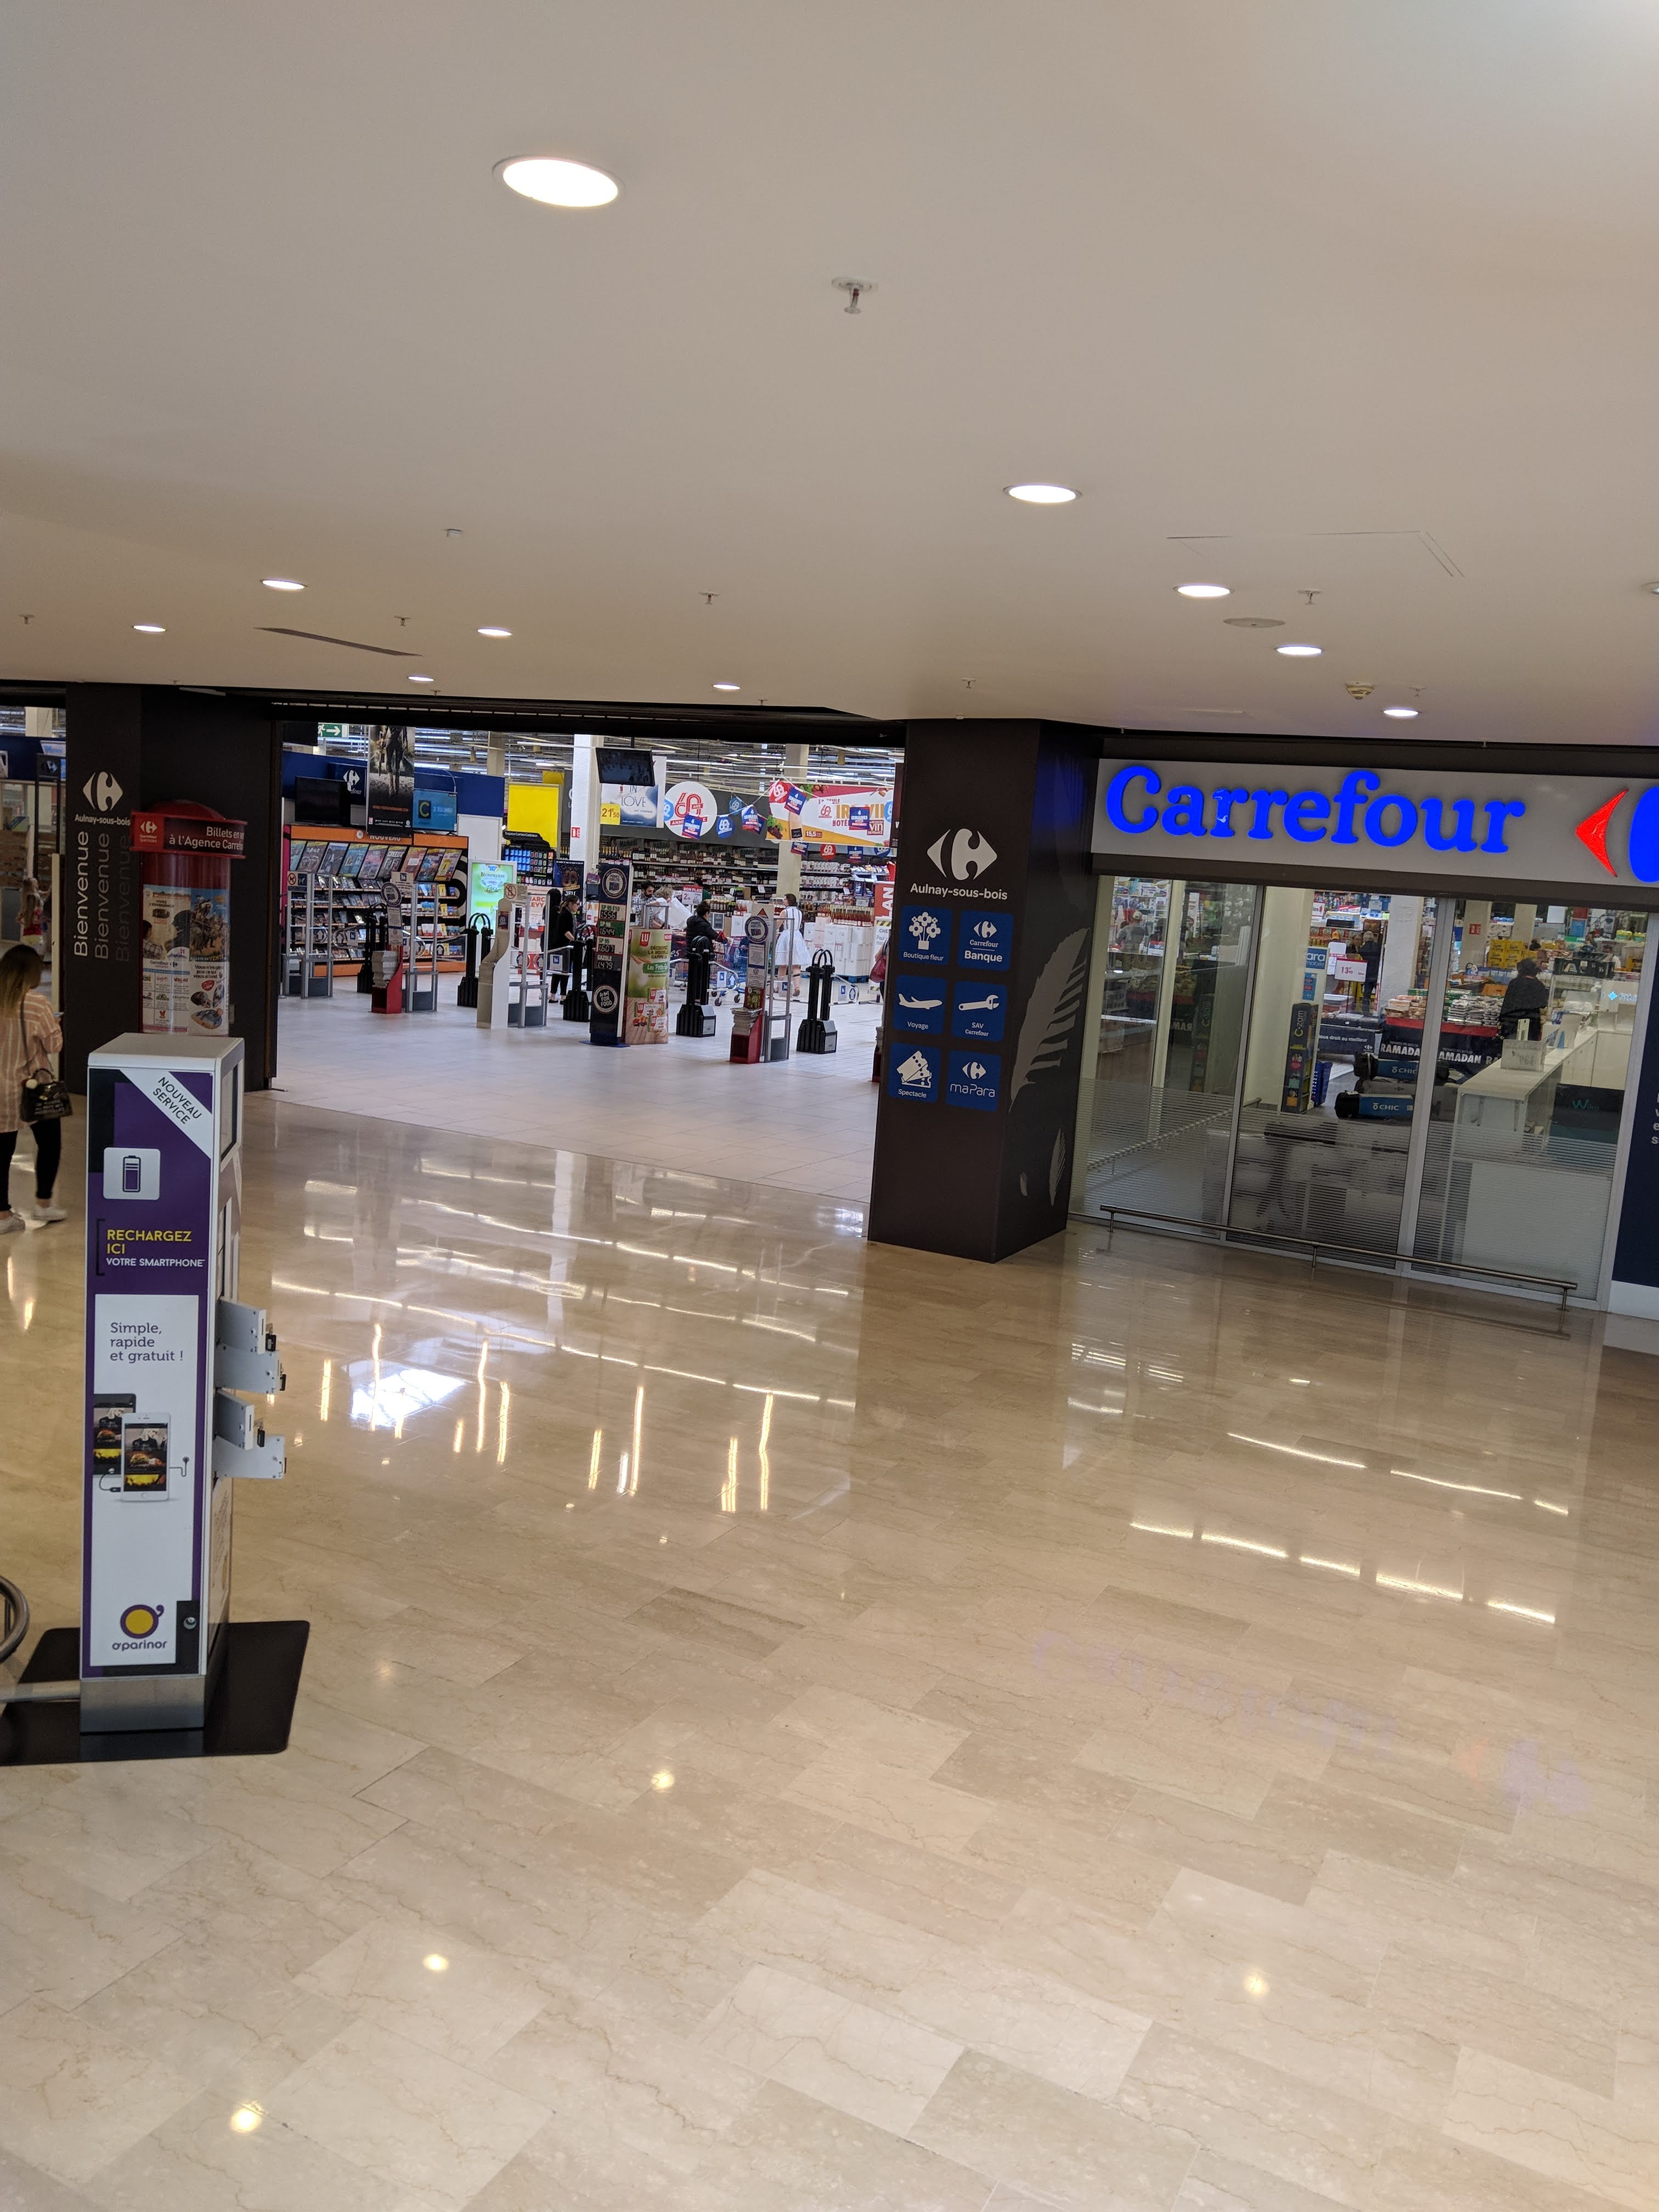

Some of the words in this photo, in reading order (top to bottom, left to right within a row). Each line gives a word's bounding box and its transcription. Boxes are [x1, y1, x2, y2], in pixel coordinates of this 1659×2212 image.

[621, 796, 646, 808] LOVE
[1106, 766, 1526, 854] Carrefour
[75, 814, 131, 826] Aulnay-sous-bois
[206, 826, 232, 838] Billets
[169, 834, 176, 845] à
[178, 834, 221, 849] l'Agence
[74, 831, 89, 957] Bienvenue
[95, 833, 110, 960] Bienvenue
[910, 883, 1008, 900] Aulnay-sous-bois
[641, 934, 649, 943] LU
[969, 939, 999, 948] Carrefour
[903, 951, 929, 961] Boutique
[930, 952, 944, 961] fleur
[964, 950, 1003, 963] Banque
[907, 1021, 929, 1030] Voyage
[1380, 1042, 1420, 1057] RAMADA
[1438, 1051, 1482, 1064] AMADAN
[157, 1076, 202, 1119] NOUVEAU
[898, 1088, 927, 1098] Spectacle
[153, 1088, 190, 1125] SERVICE
[107, 1229, 192, 1243] RECHARGEZ
[107, 1243, 126, 1255] ICI
[106, 1257, 137, 1266] VOTRE
[110, 1322, 162, 1336] Simple,
[110, 1336, 155, 1350] rapide
[110, 1351, 123, 1361] et
[128, 1350, 175, 1364] gratuit
[179, 1350, 183, 1361] !
